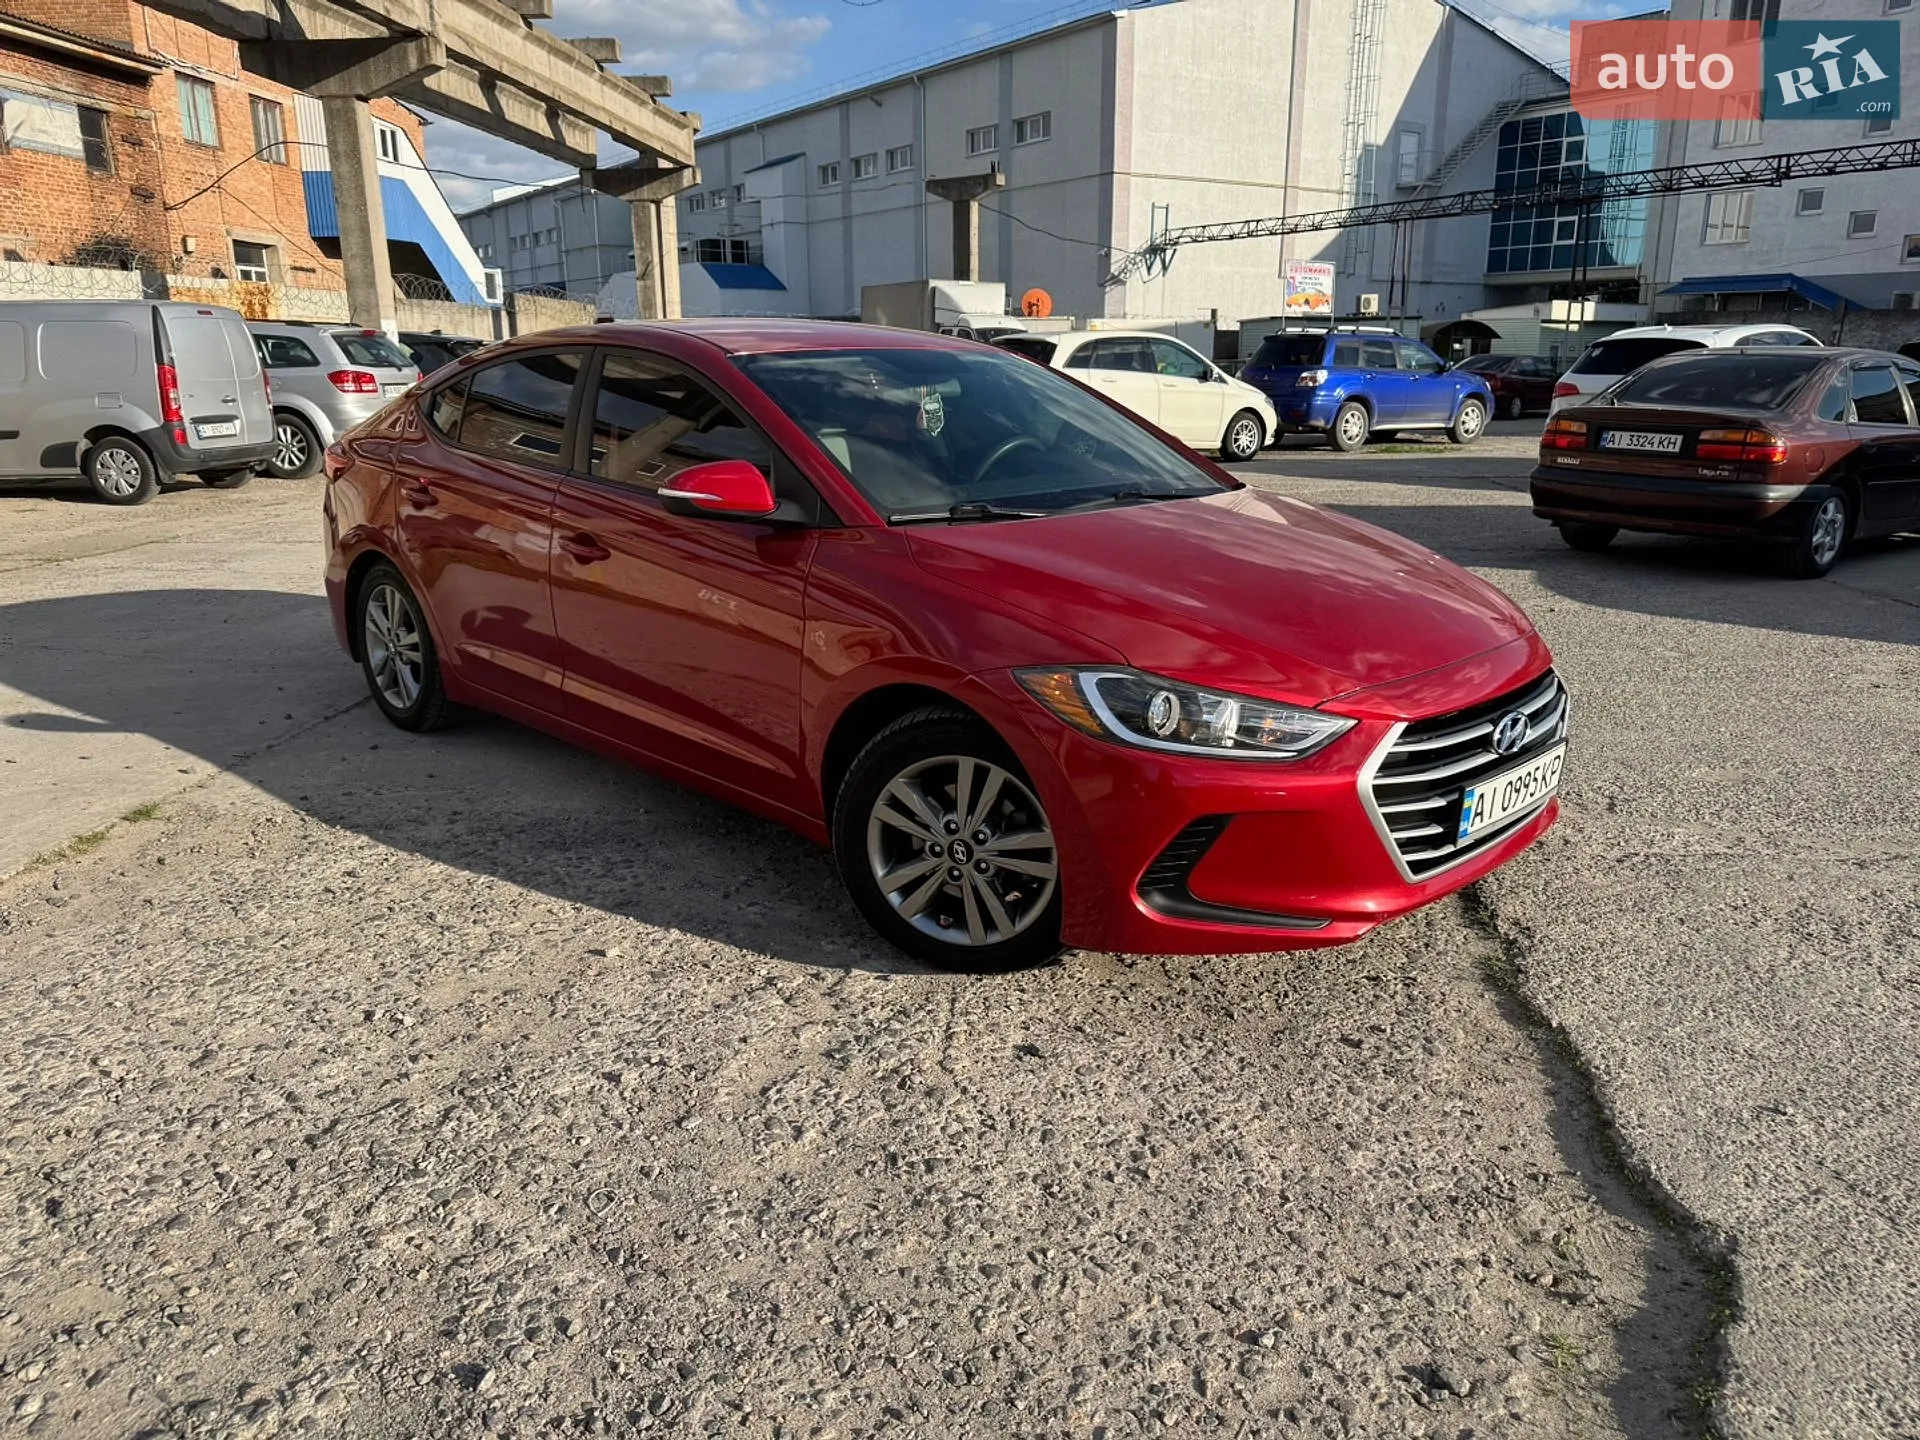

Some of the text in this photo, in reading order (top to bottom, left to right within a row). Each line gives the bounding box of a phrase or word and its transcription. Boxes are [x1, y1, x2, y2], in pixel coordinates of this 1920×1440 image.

[1626, 434, 1656, 448] 3324
[1657, 436, 1678, 449] KH
[1501, 766, 1540, 812] 0995
